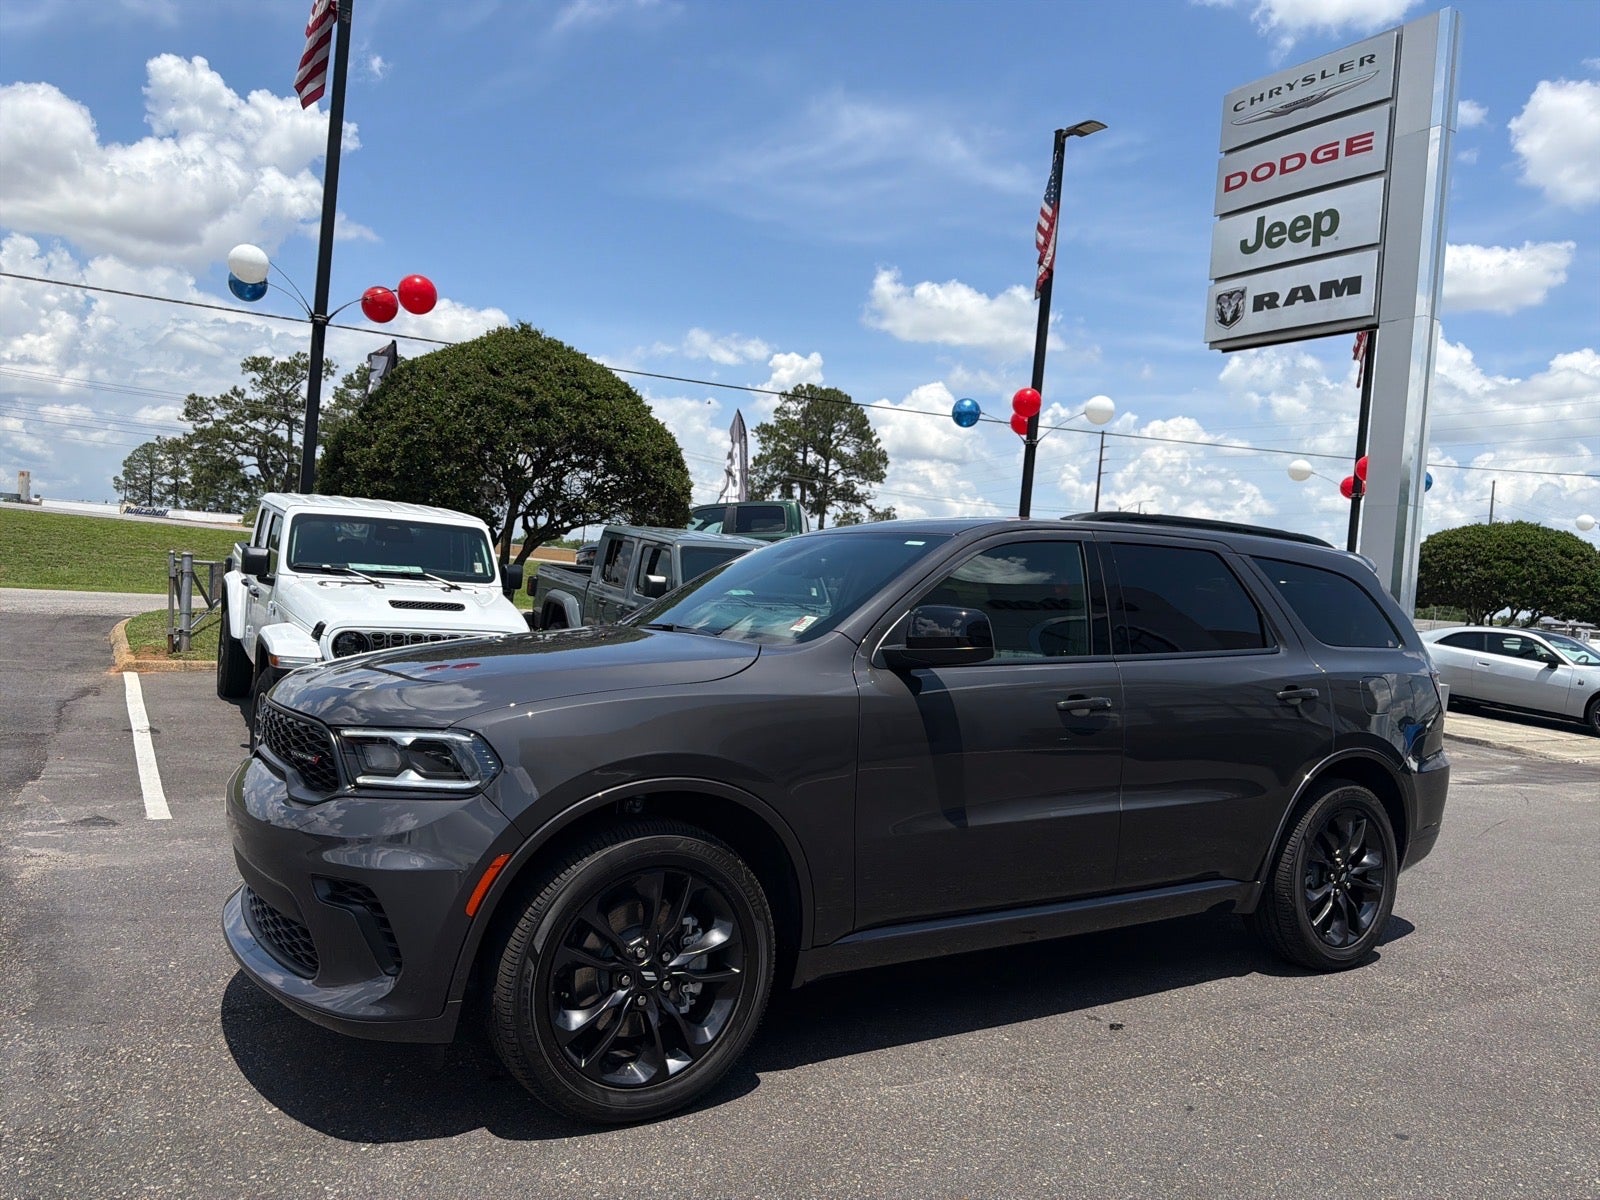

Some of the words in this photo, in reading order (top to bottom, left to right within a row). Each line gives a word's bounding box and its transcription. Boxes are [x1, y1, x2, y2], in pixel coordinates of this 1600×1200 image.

[1233, 53, 1376, 112] CHRYSLER
[1224, 131, 1375, 193] DODGE
[1239, 208, 1340, 255] Jeep
[1252, 275, 1362, 313] RAM
